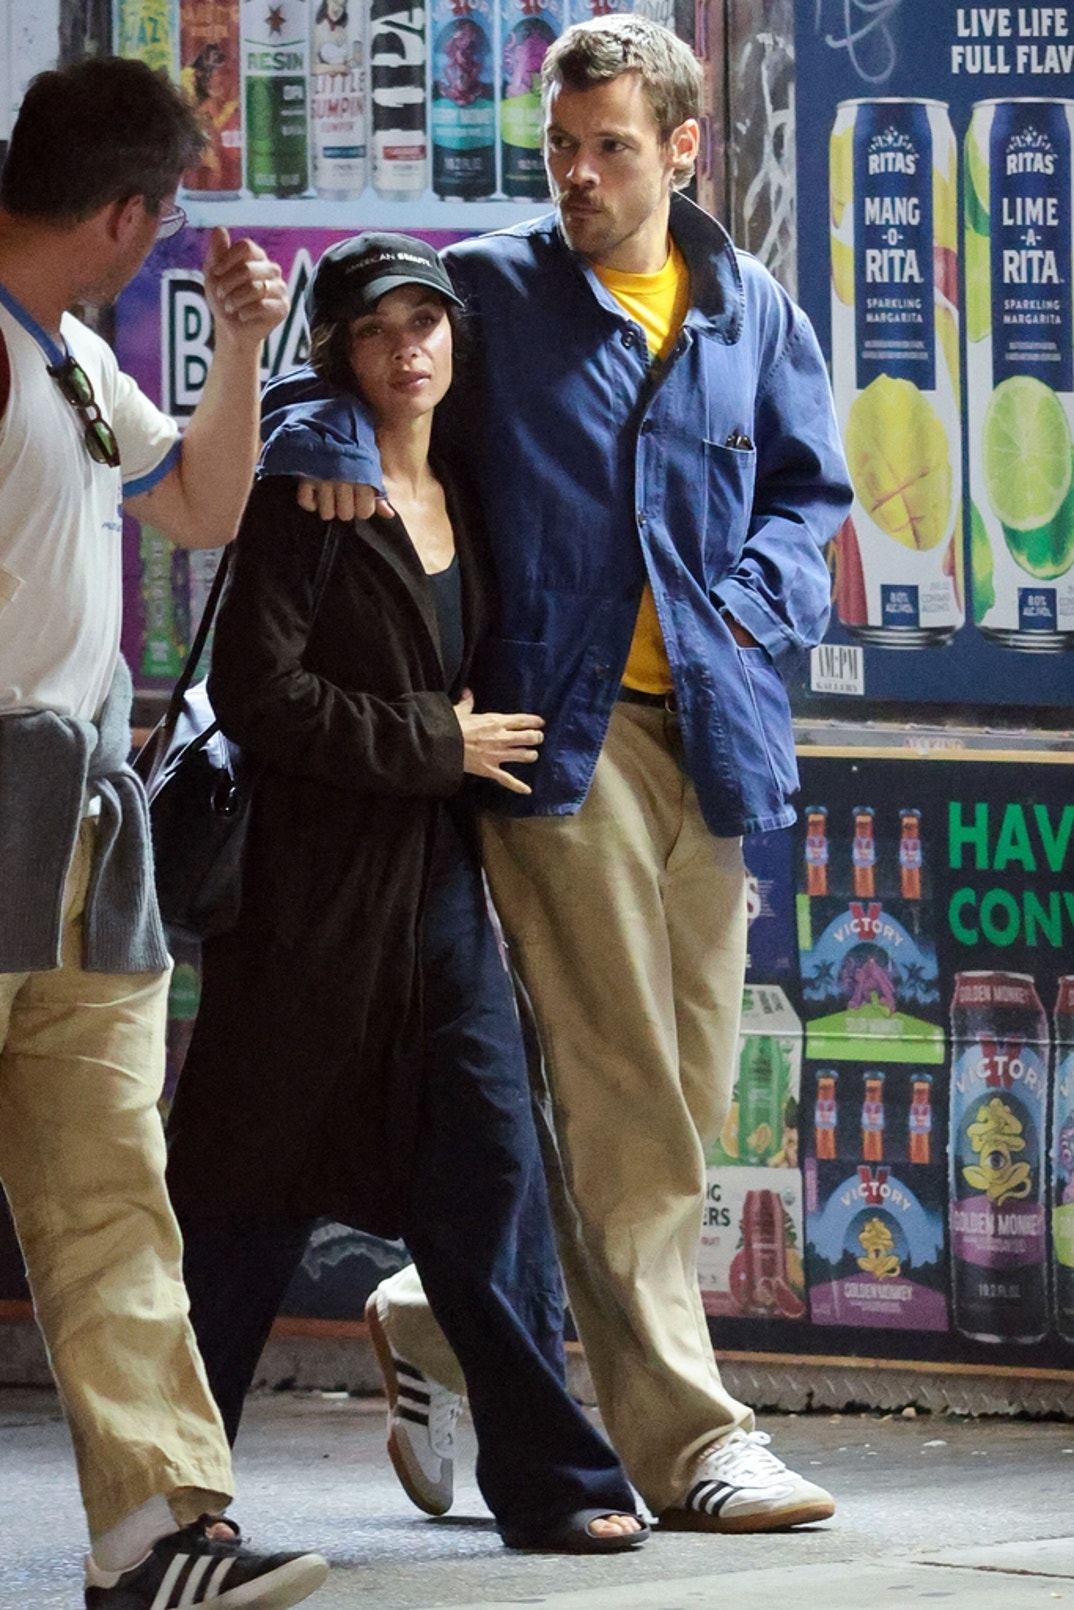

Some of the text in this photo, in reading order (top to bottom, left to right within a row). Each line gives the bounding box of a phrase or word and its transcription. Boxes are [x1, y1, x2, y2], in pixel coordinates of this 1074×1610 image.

[956, 8, 1068, 37] LIVE LIFE
[247, 51, 304, 71] RESIN
[951, 45, 1074, 75] FULL FLAV
[868, 151, 917, 176] RITAS
[1006, 151, 1055, 176] RITAS
[864, 197, 920, 226] MANG
[1002, 197, 1059, 226] LIME
[866, 250, 921, 283] RITA
[1003, 250, 1060, 284] RITA
[866, 298, 922, 310] SPARKLING
[866, 312, 923, 324] MARGARITA
[1003, 299, 1060, 311] SPARKLING
[1003, 313, 1062, 325] MARGARITA
[948, 801, 1074, 872] HAV
[833, 917, 904, 947] VICTORY
[956, 1055, 1045, 1100] VICTORY
[840, 1181, 912, 1212] VICTORY
